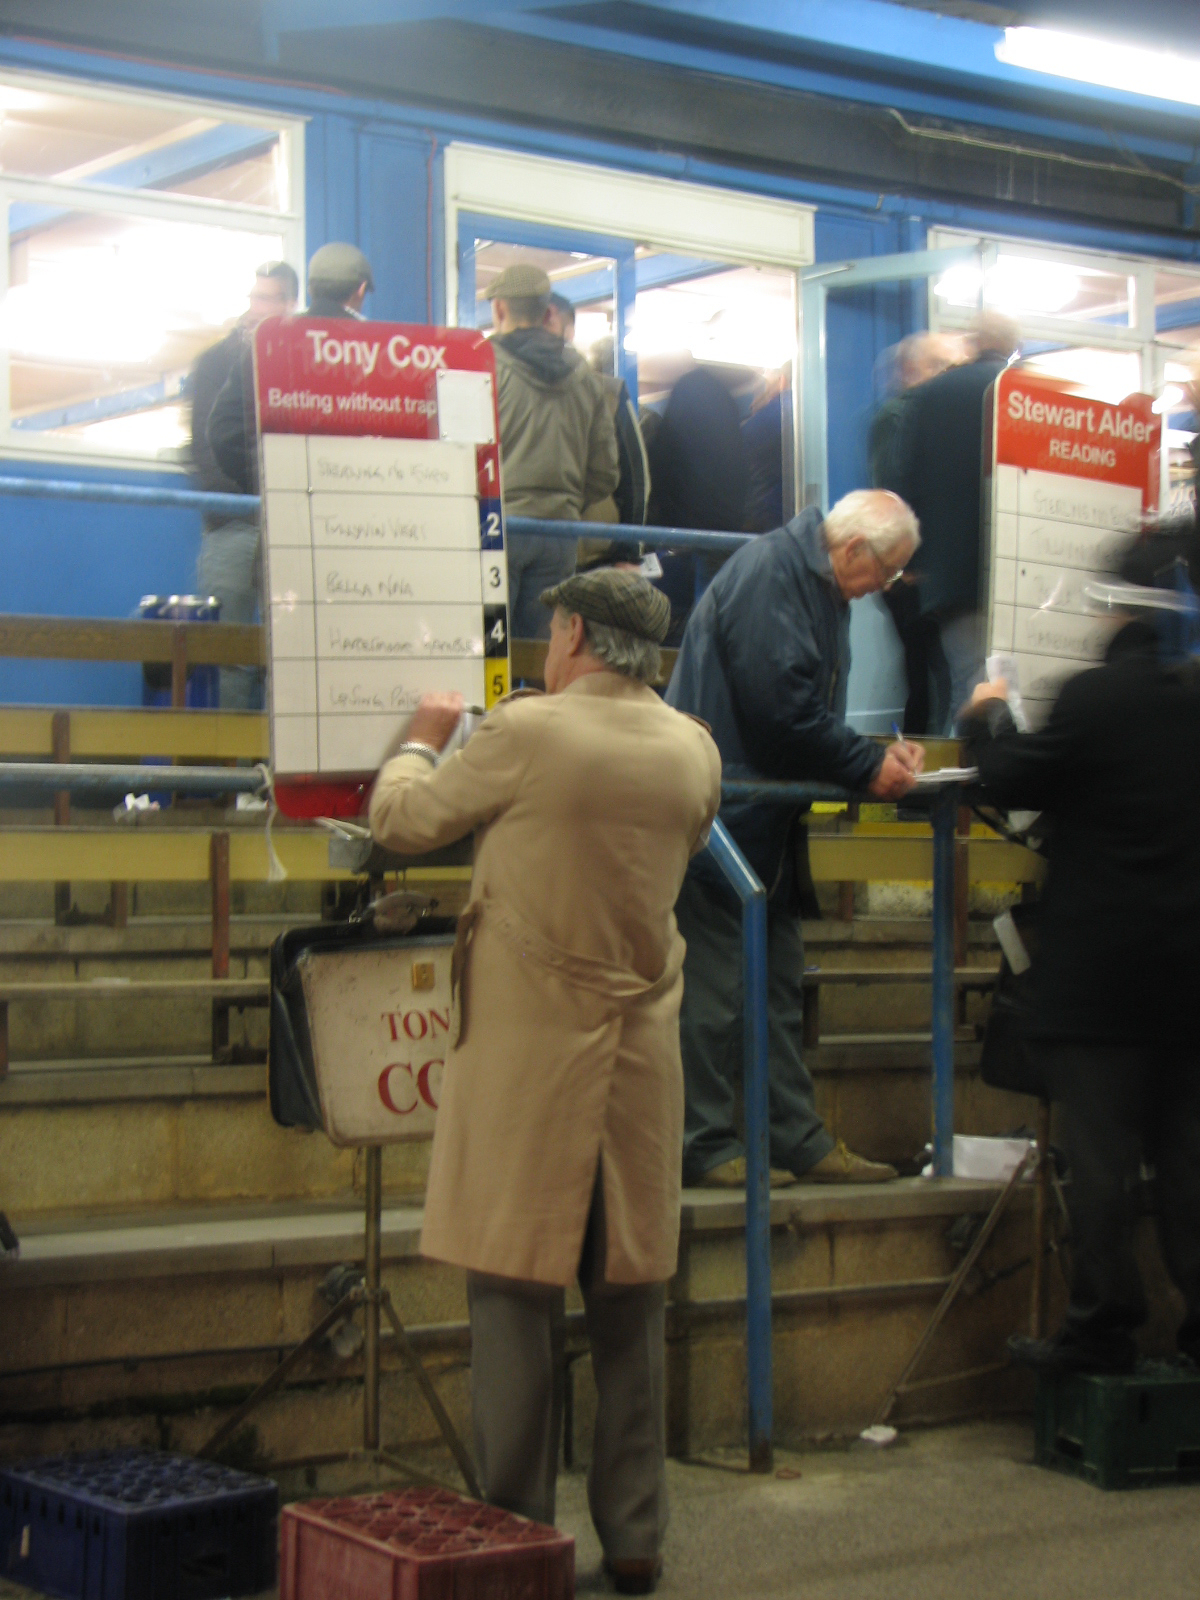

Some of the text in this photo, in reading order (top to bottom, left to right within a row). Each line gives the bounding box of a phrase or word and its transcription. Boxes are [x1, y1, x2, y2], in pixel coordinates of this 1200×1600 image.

[305, 329, 448, 375] Tony Cox
[267, 387, 333, 414] Betting
[336, 391, 402, 413] without
[1007, 390, 1155, 444] Stewart Alder
[1049, 439, 1117, 468] READING
[483, 459, 495, 483] 1
[486, 512, 500, 536] 2
[489, 566, 501, 588] 3
[490, 619, 505, 643] 4
[492, 675, 504, 696] 5
[380, 1007, 451, 1042] TON
[378, 1058, 445, 1115] CO
